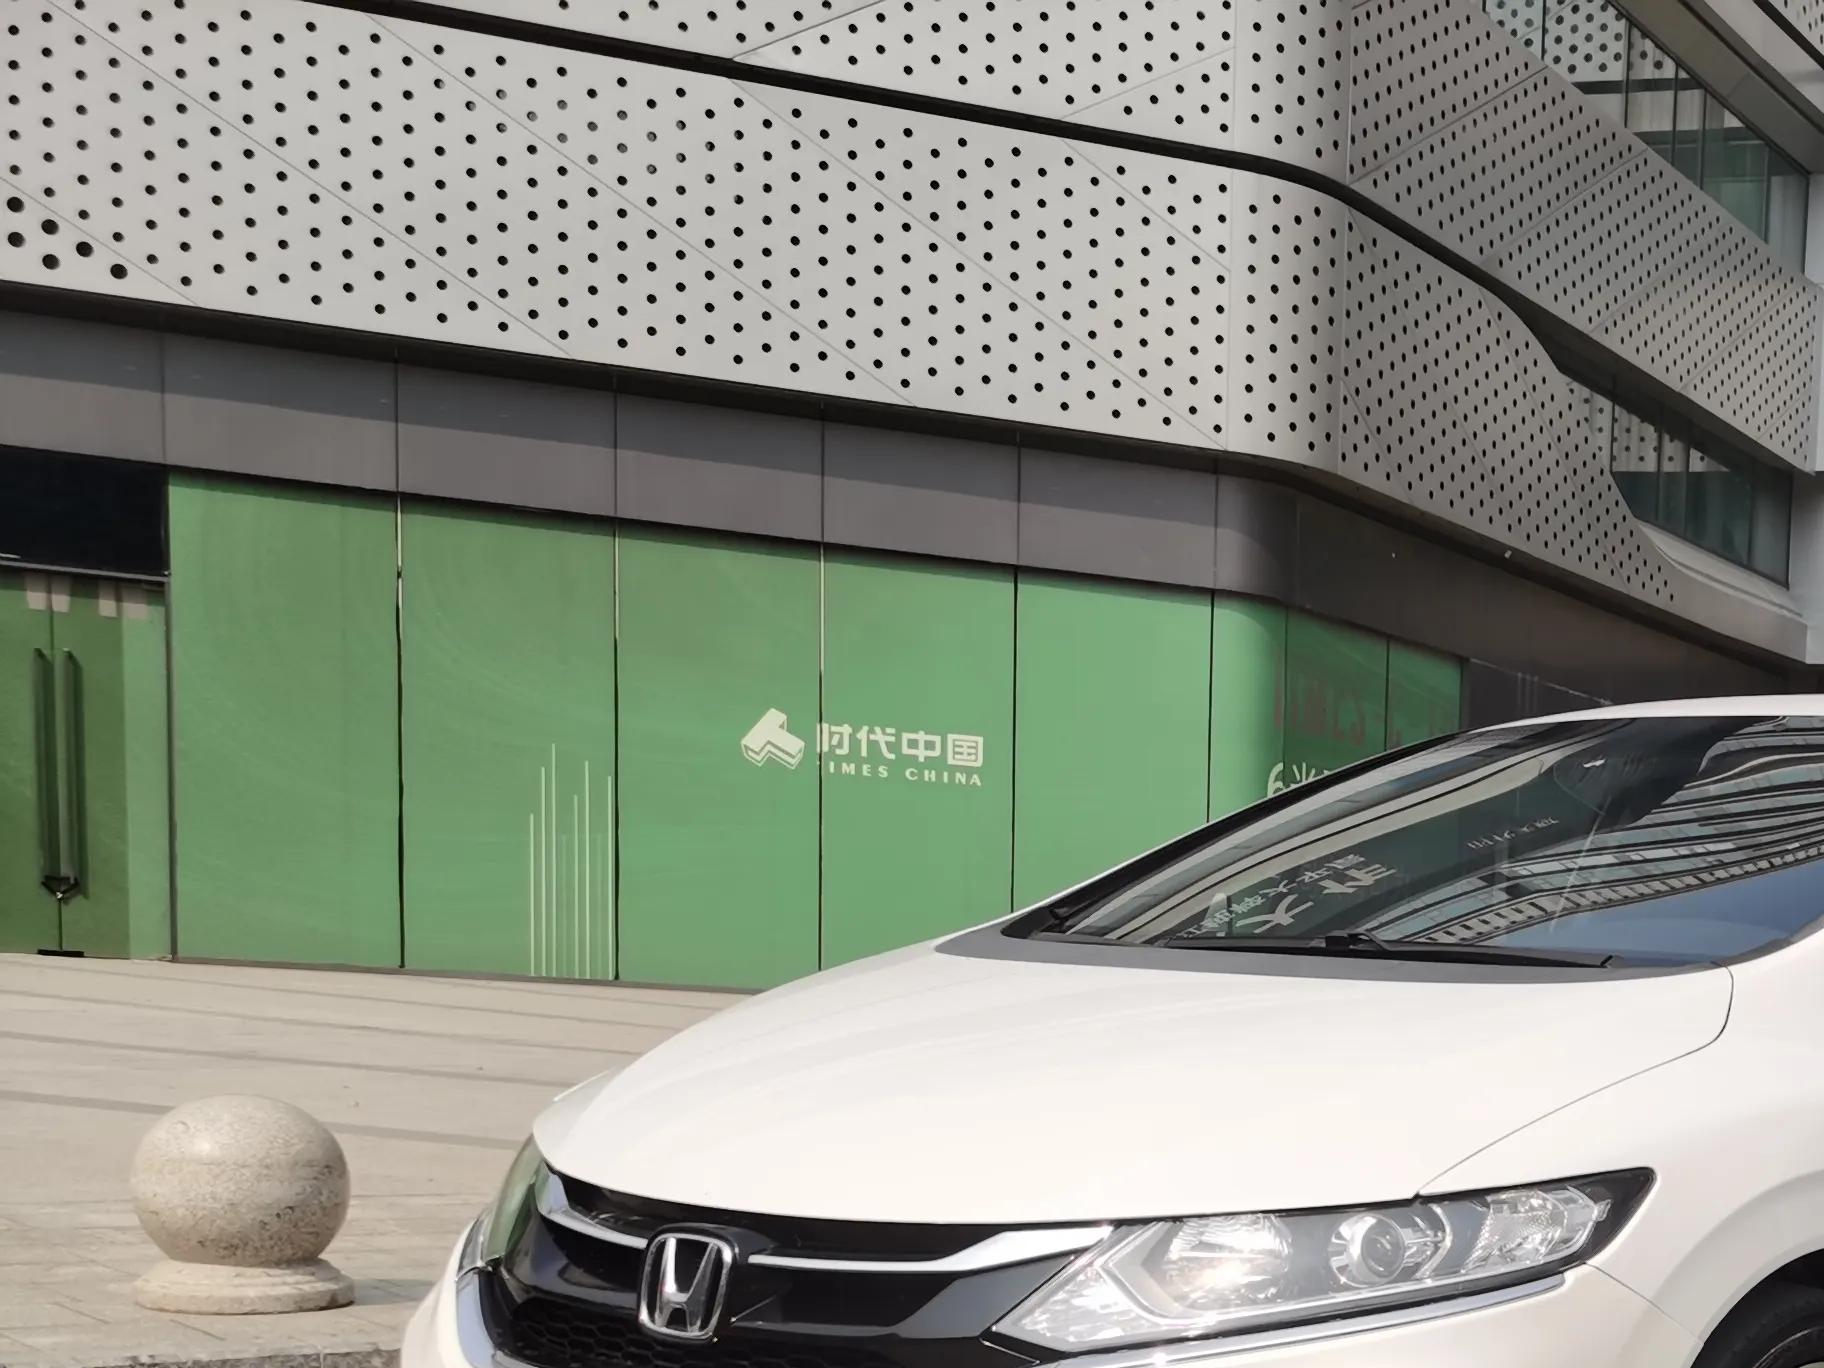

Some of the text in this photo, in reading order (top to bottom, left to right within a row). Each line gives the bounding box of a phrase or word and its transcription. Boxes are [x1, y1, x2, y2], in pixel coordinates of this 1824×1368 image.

[816, 723, 984, 768] 时代中国
[816, 761, 982, 786] IMES CHINA
